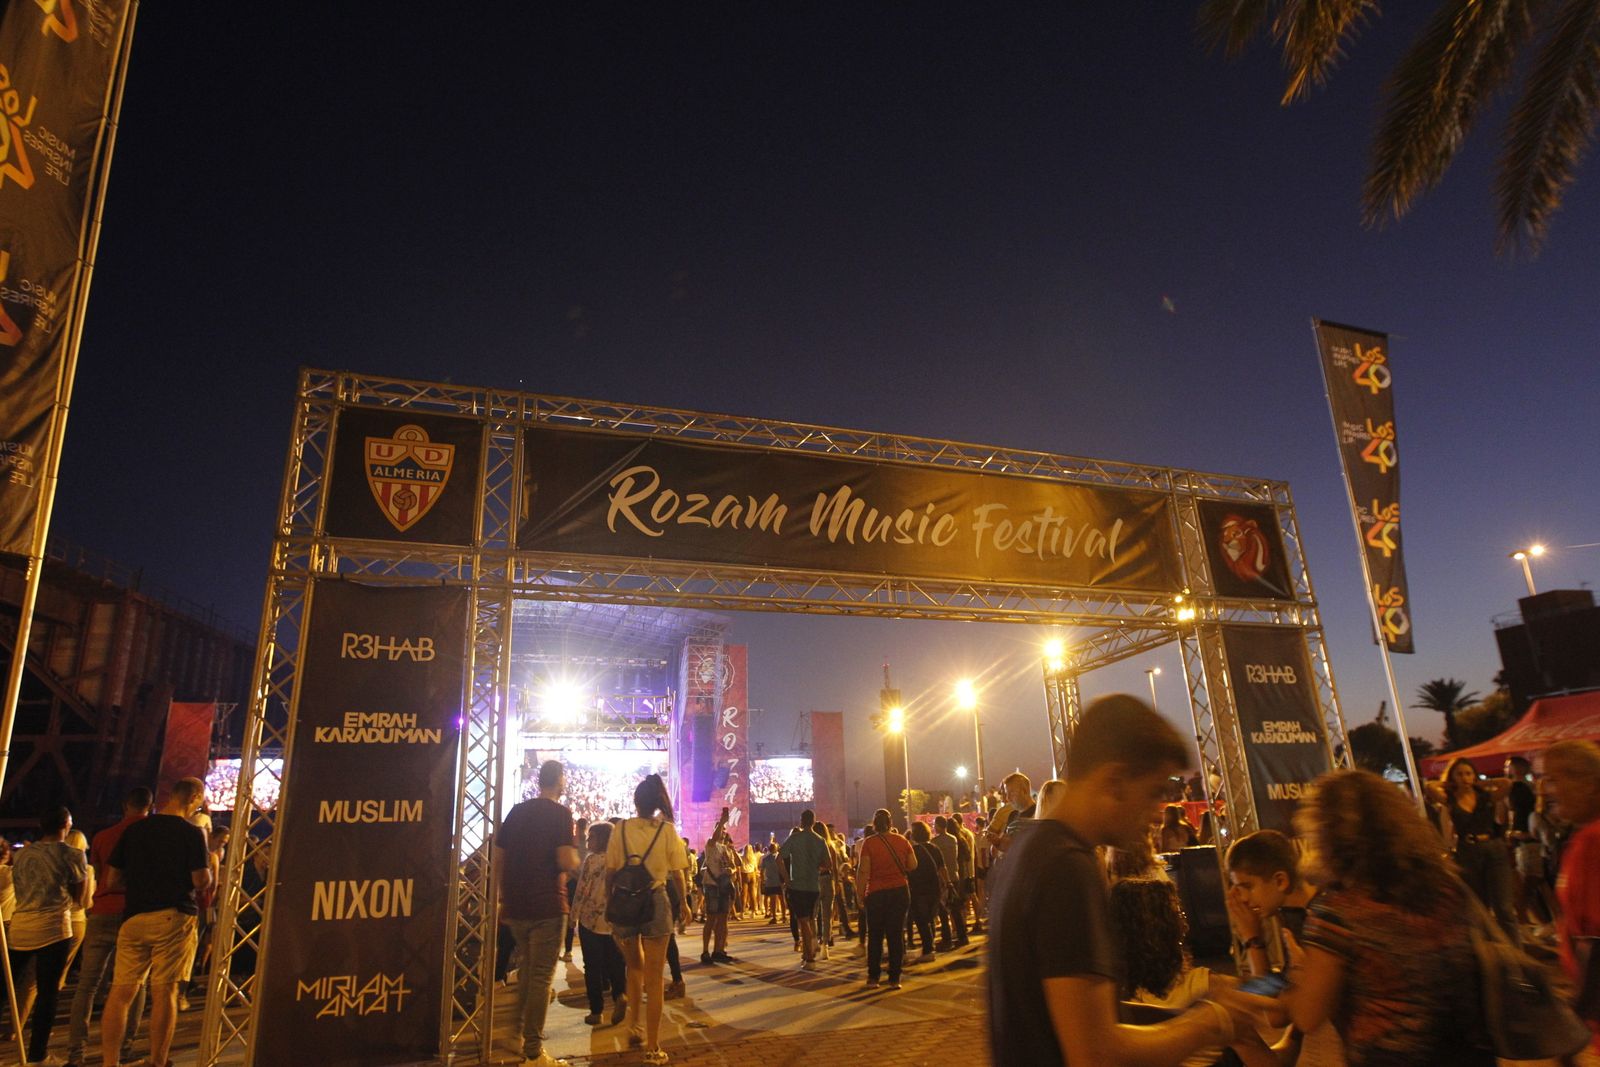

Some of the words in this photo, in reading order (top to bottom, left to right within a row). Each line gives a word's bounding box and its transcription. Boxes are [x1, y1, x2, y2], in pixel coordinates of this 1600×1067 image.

[373, 466, 441, 482] ALMERIA
[607, 465, 788, 537] Rozam
[809, 484, 958, 547] Music
[972, 503, 1125, 564] Festival
[340, 632, 436, 663] R3HAB
[1245, 664, 1297, 685] R3HAB
[343, 711, 418, 728] EMRAH
[1262, 720, 1302, 733] EMRAH
[314, 727, 442, 744] KARADUMAN
[1267, 783, 1317, 800] MUSL
[318, 799, 424, 824] MUSLIM
[311, 879, 414, 921] NIXON
[296, 972, 405, 1001] MIRIAM
